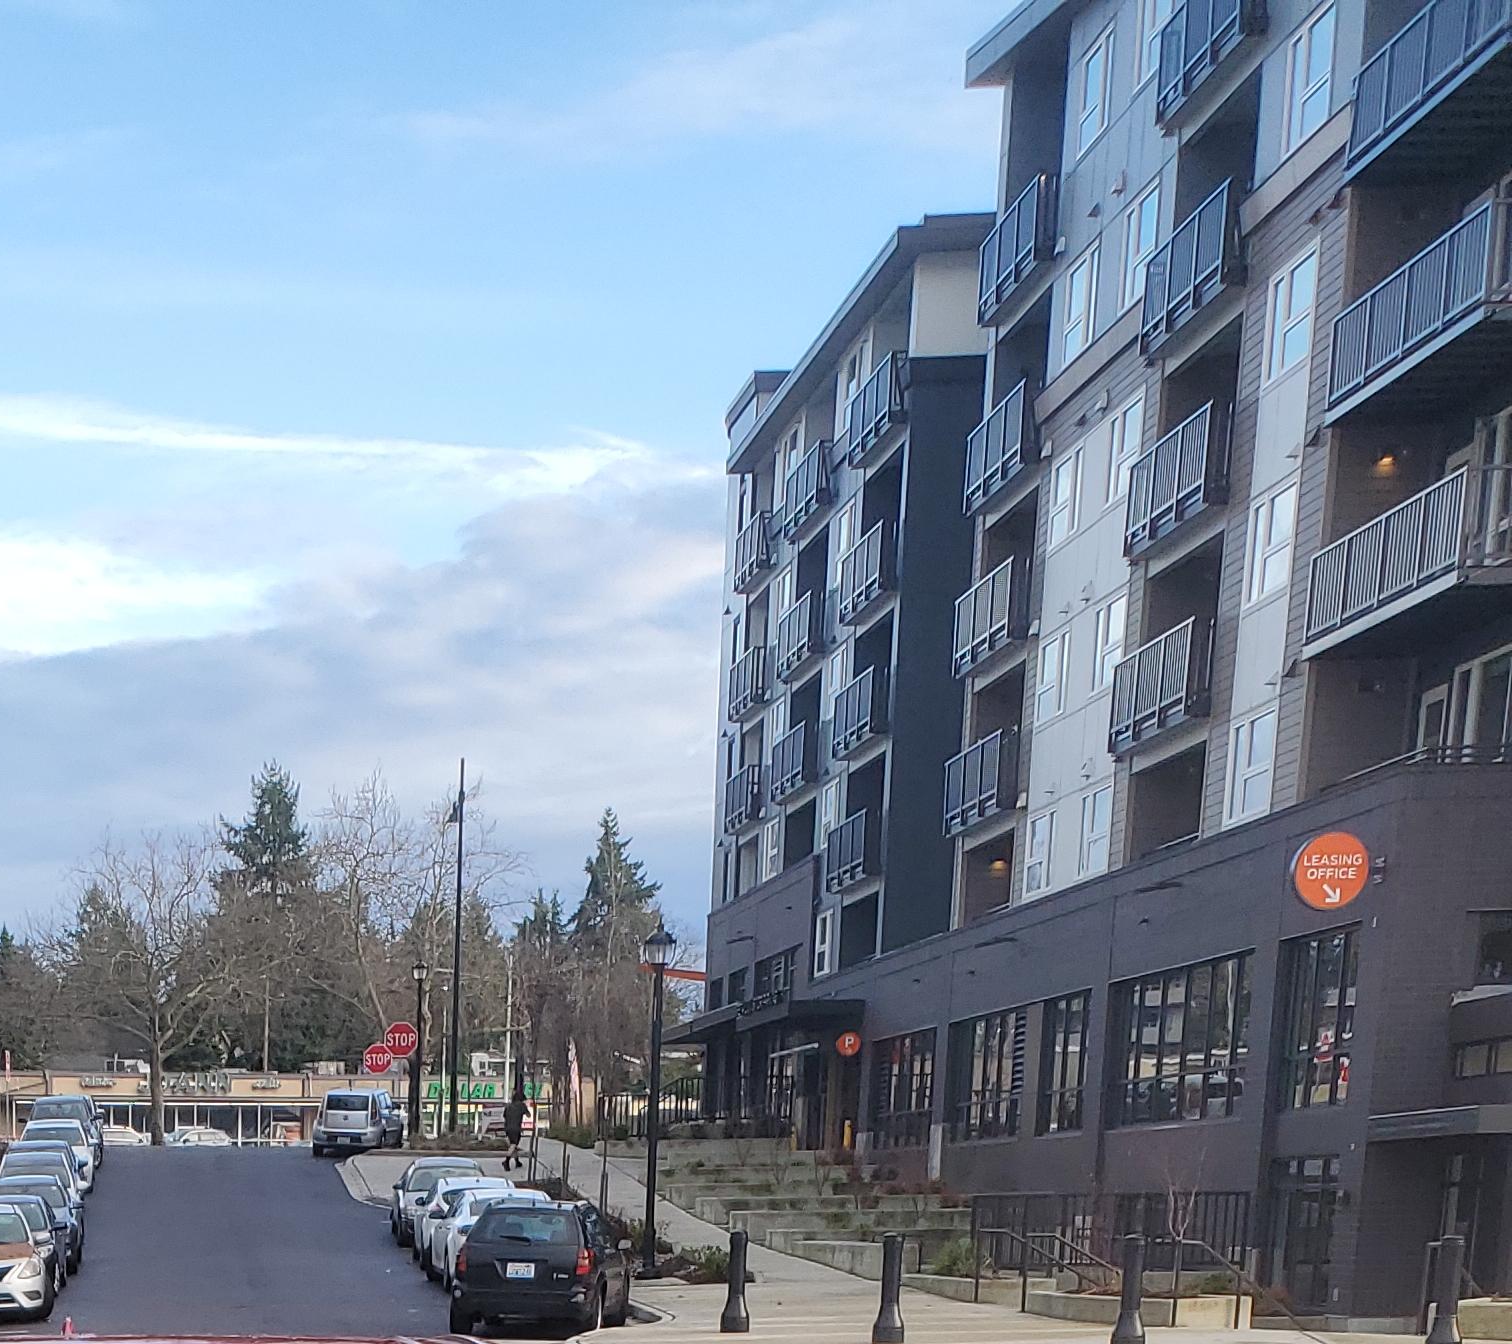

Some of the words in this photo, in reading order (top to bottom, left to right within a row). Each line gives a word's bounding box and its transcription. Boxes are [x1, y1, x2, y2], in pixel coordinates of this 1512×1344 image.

[1303, 853, 1363, 867] LEASING
[1306, 867, 1358, 880] OFFICE
[386, 1032, 416, 1047] STOP
[845, 1036, 855, 1049] P
[365, 1053, 391, 1066] STOP
